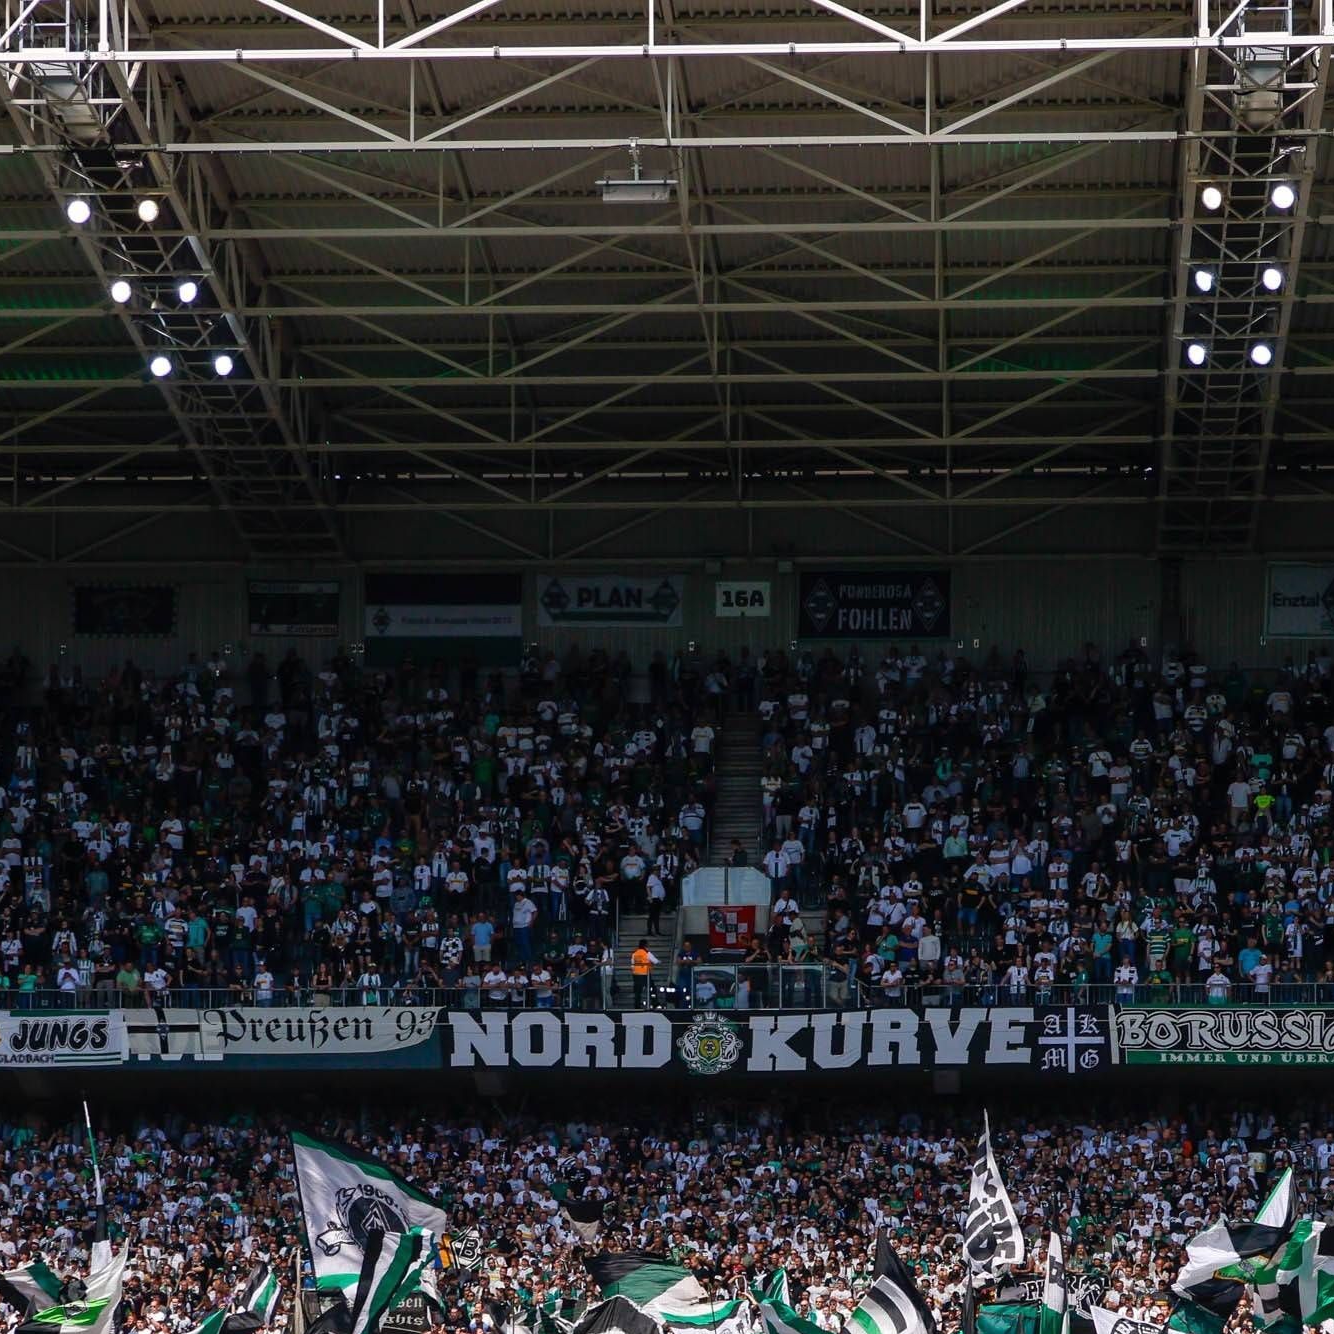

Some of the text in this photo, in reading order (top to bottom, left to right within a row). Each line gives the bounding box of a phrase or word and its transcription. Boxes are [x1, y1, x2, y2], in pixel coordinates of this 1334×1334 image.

[576, 587, 643, 609] PLAN
[721, 590, 764, 608] 16A
[1272, 592, 1320, 607] Enztal
[837, 607, 913, 631] FOHLEN
[8, 1017, 110, 1054] JUNGS
[447, 1008, 1035, 1072] NORD KURVE
[1160, 1053, 1226, 1064] IMMER
[1236, 1053, 1272, 1064] UND
